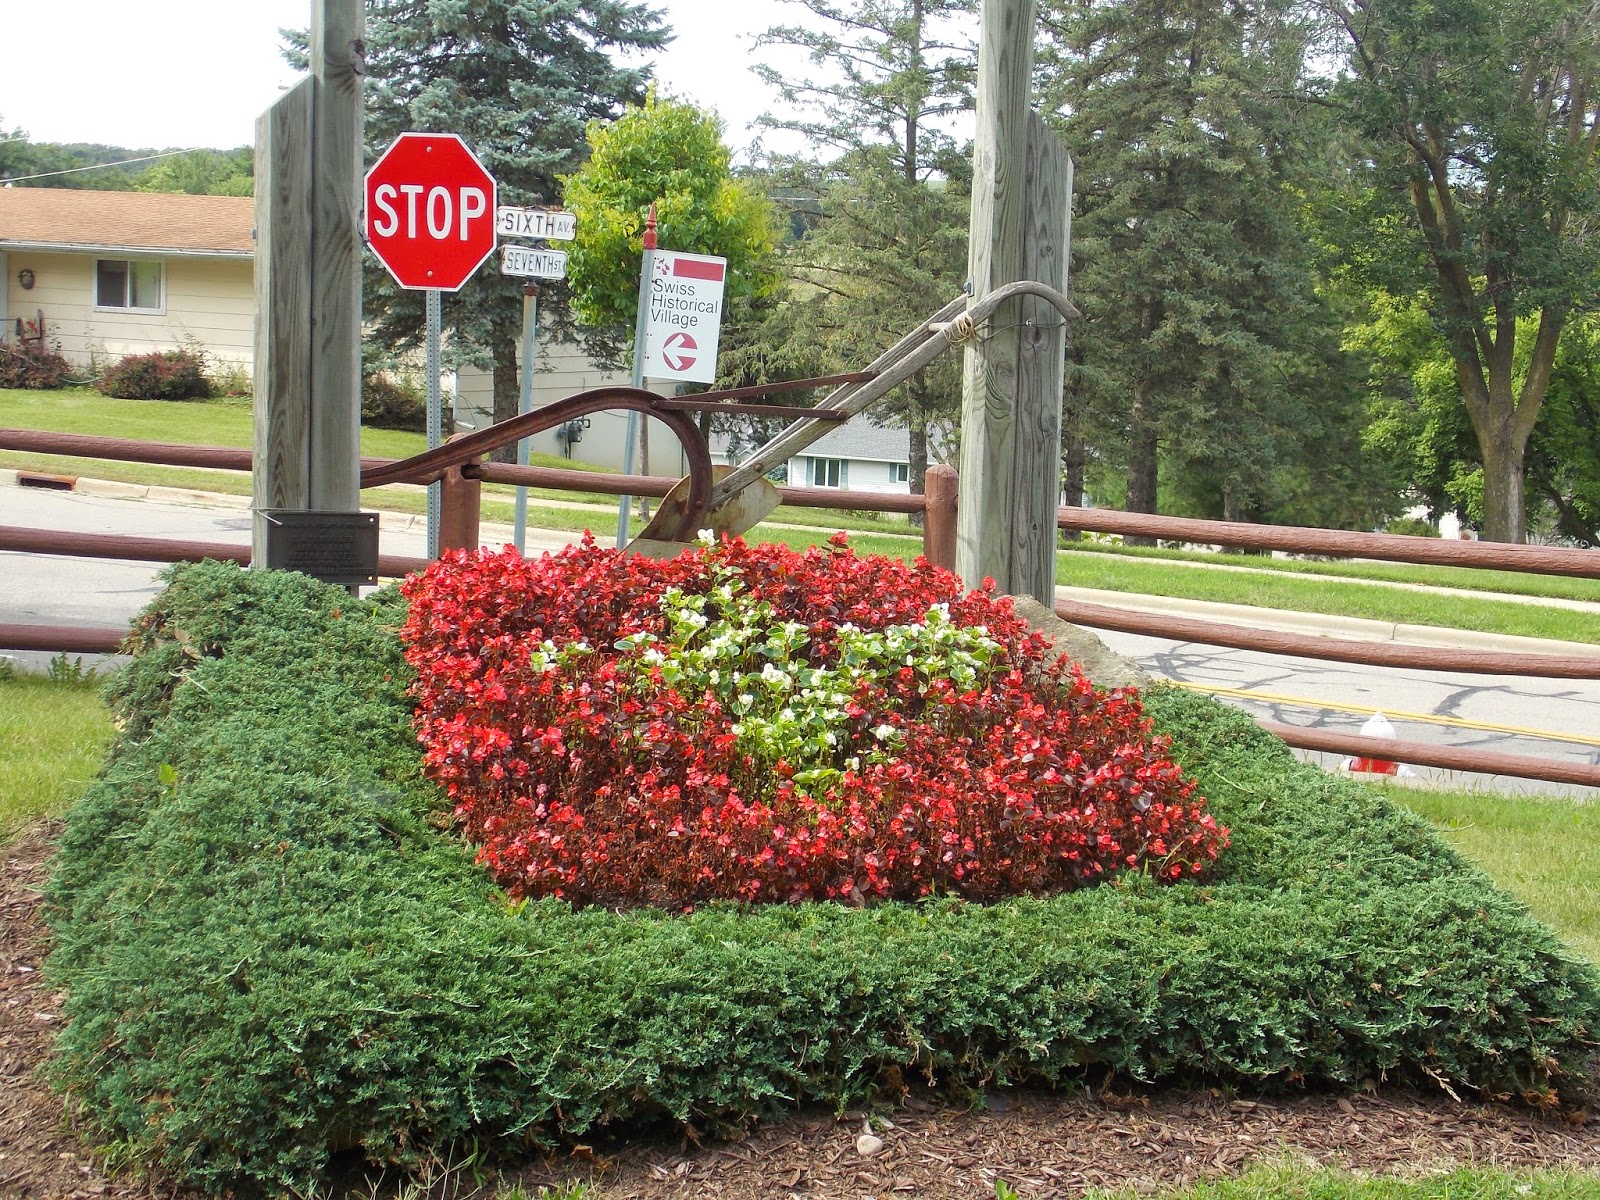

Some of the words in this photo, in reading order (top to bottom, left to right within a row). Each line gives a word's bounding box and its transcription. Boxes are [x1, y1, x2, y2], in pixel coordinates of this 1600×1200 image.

[374, 183, 486, 241] STOP
[505, 213, 555, 235] SIXTH
[506, 251, 554, 274] SEVENTH
[653, 278, 695, 296] Swiss
[652, 294, 718, 313] Historical
[651, 309, 698, 329] Village
